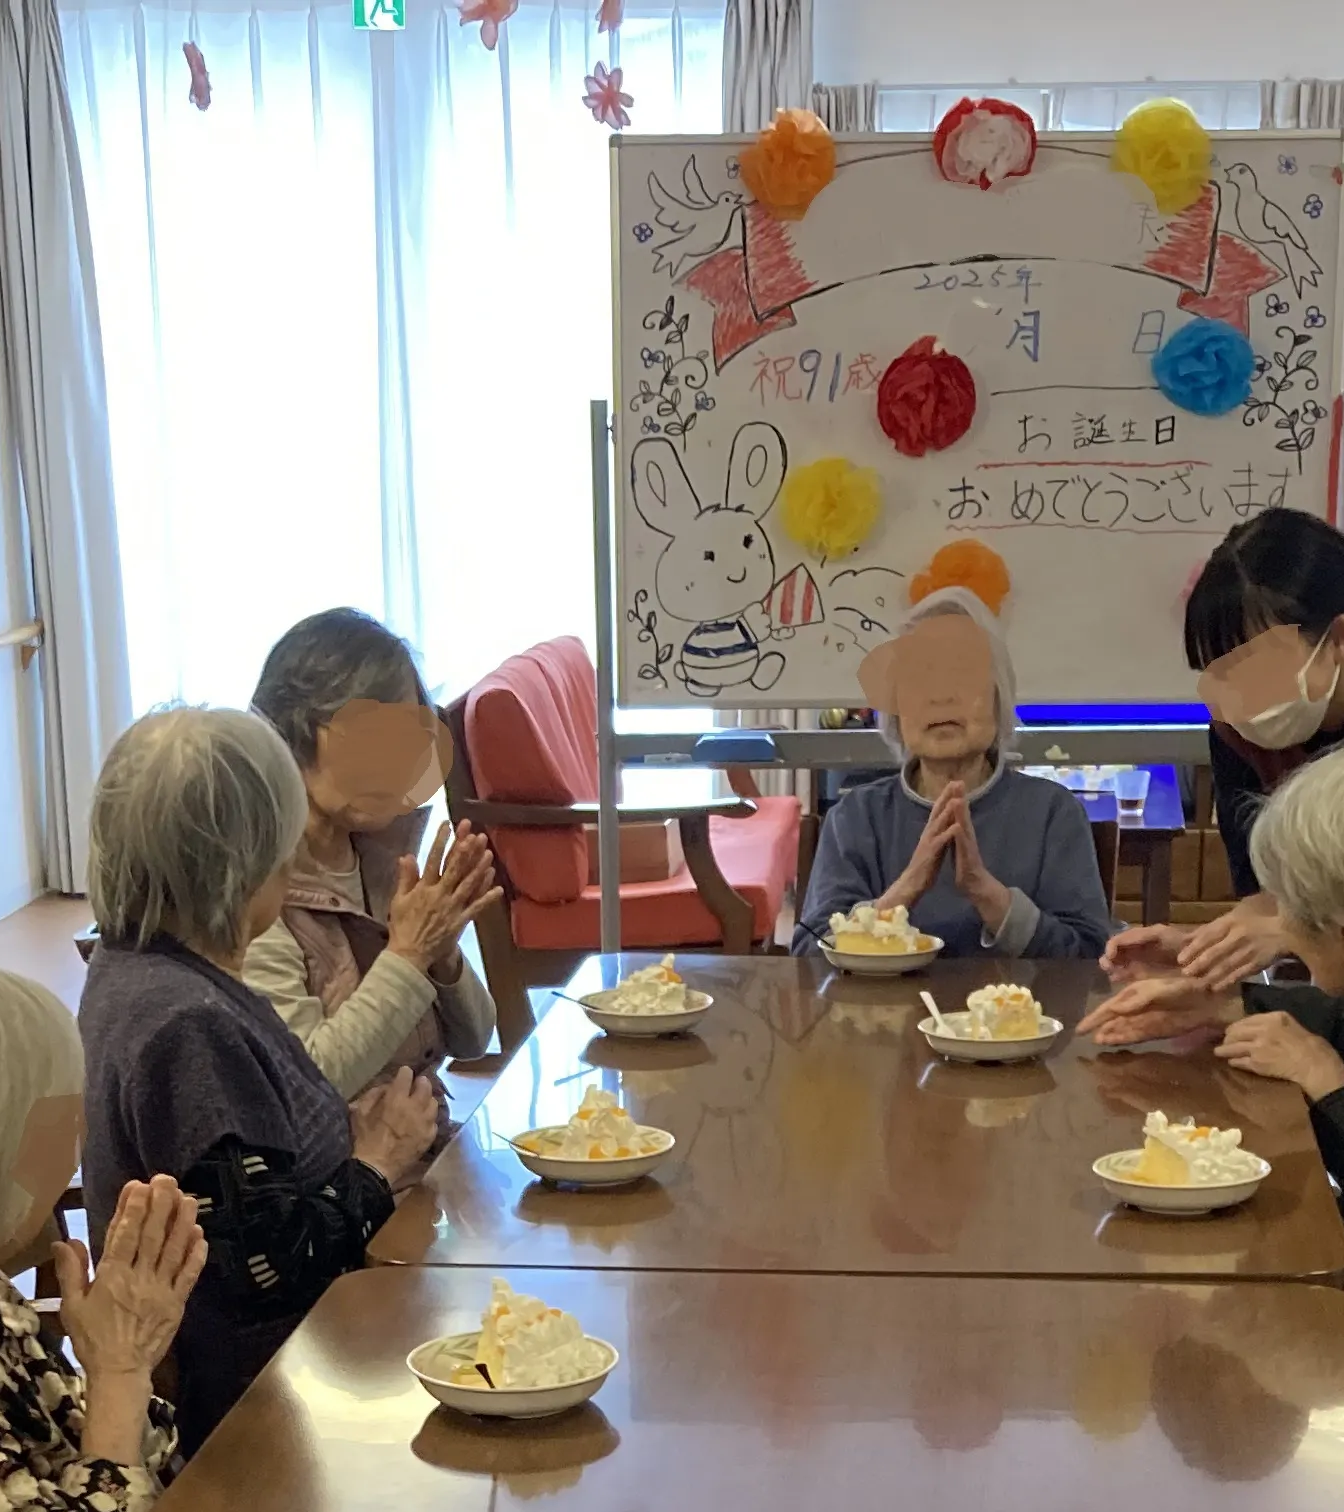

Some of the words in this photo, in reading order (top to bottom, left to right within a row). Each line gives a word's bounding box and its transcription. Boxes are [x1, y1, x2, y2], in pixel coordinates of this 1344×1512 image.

[914, 264, 1042, 304] 2025年
[749, 348, 883, 408] 祝91歳
[1017, 411, 1176, 453] お誕生日
[947, 462, 1291, 528] おめでとうございます
